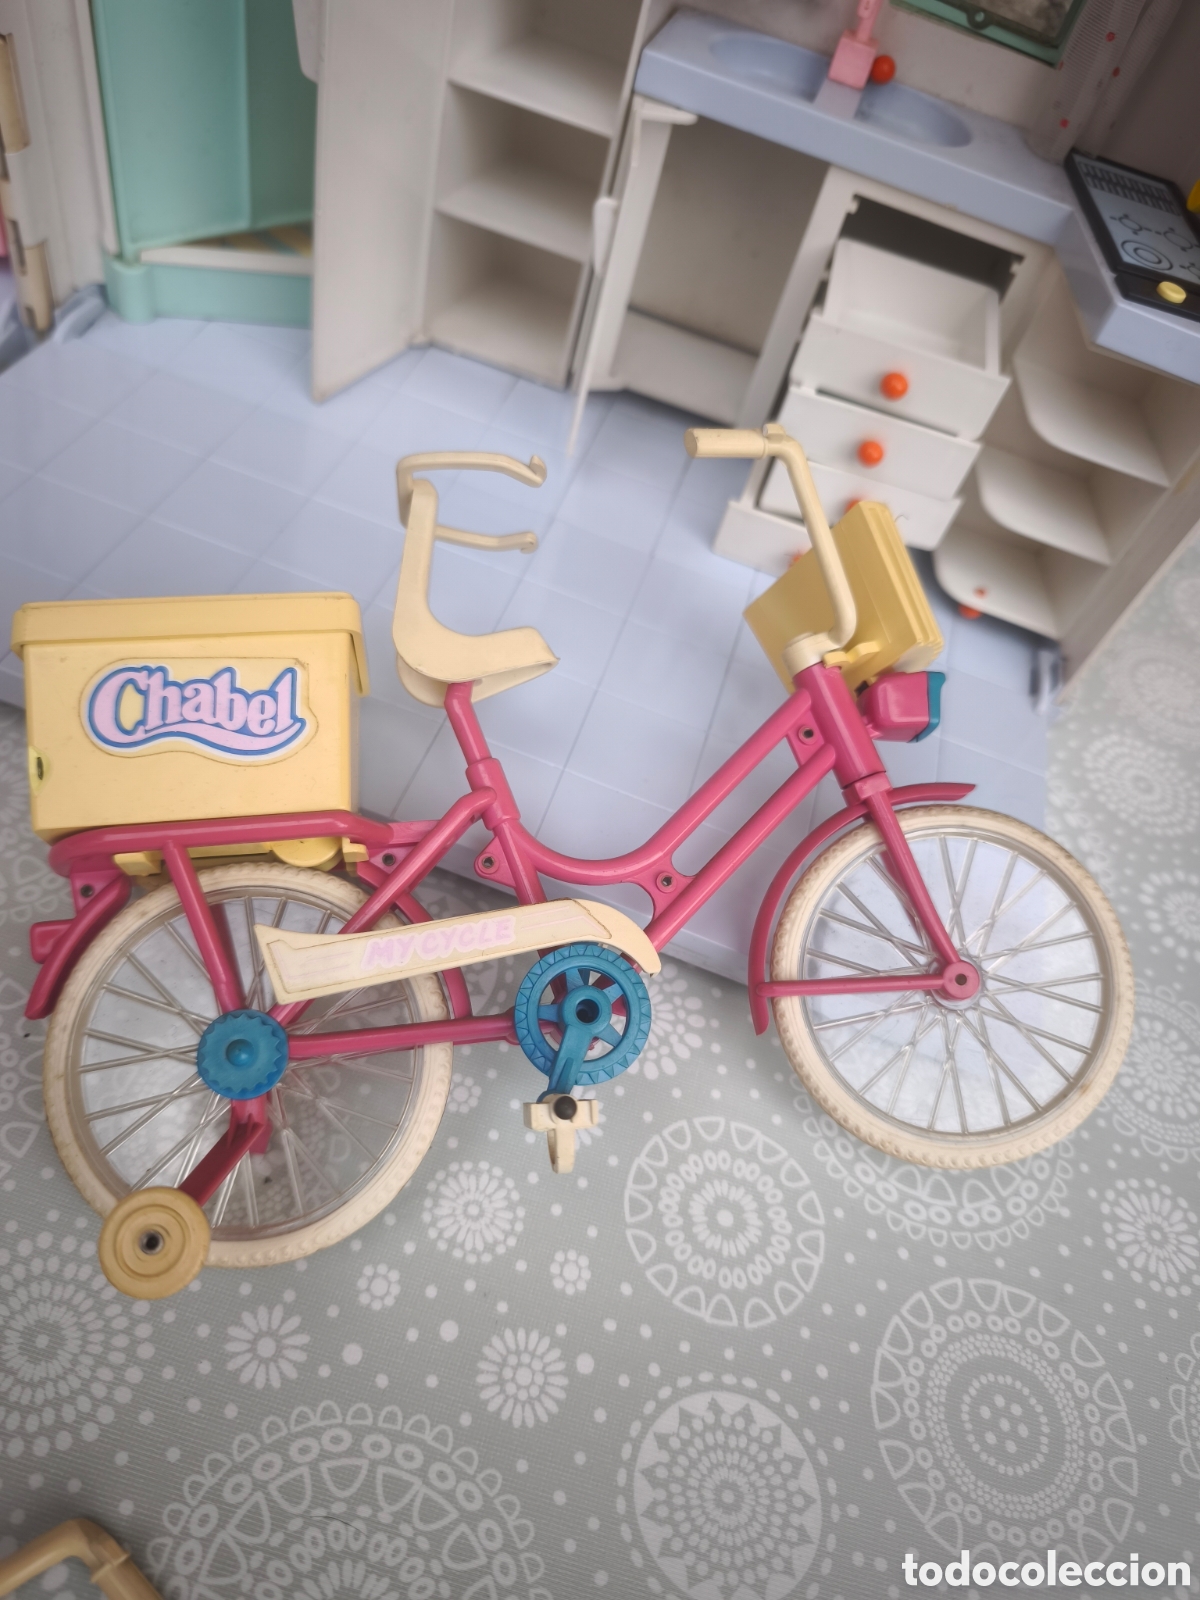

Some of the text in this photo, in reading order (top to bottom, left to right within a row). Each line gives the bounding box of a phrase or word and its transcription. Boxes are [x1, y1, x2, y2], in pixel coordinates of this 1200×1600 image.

[88, 665, 307, 756] Chabel
[365, 917, 513, 967] MY CYCLE
